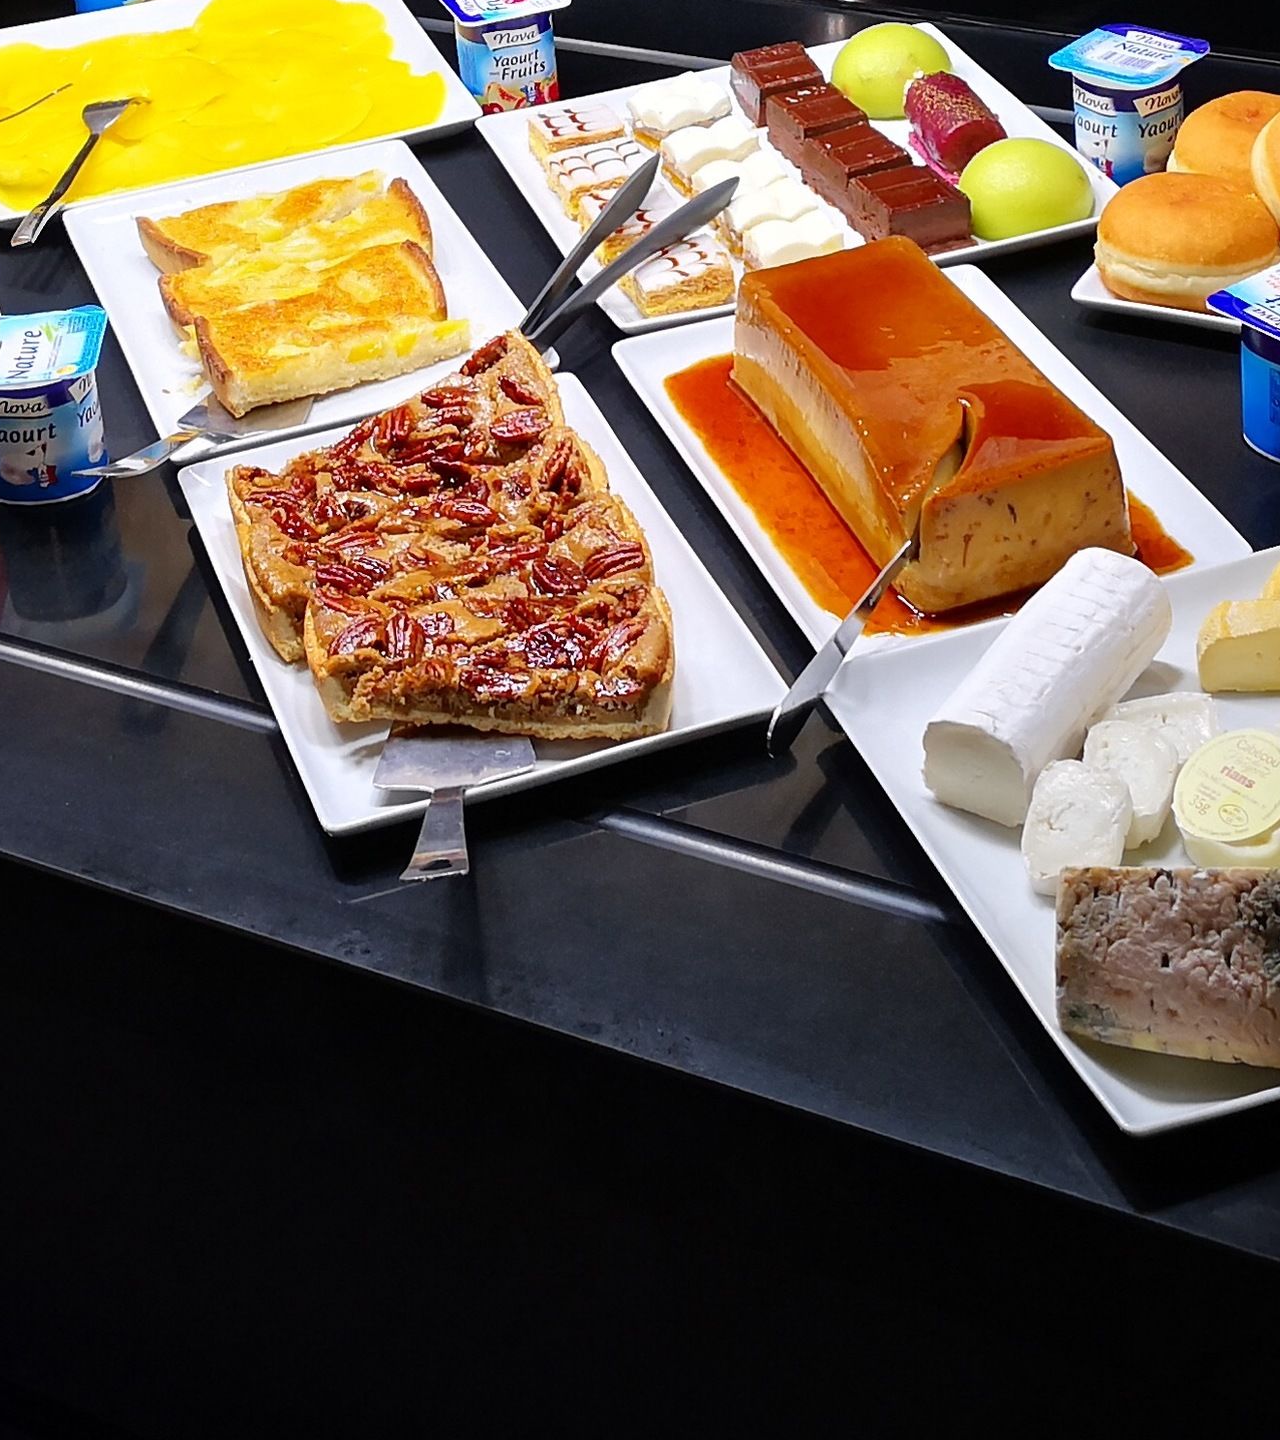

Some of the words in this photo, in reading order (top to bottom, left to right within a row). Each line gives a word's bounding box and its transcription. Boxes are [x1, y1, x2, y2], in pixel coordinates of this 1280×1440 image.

[493, 29, 536, 45] Nova
[493, 49, 539, 67] Yaourt
[1115, 42, 1173, 60] Nature
[501, 61, 546, 80] Fruits
[1075, 89, 1110, 111] Nova
[1074, 111, 1118, 137] aourt
[14, 329, 42, 379] Nature
[1220, 765, 1256, 789] rians
[1188, 794, 1212, 816] 35g
